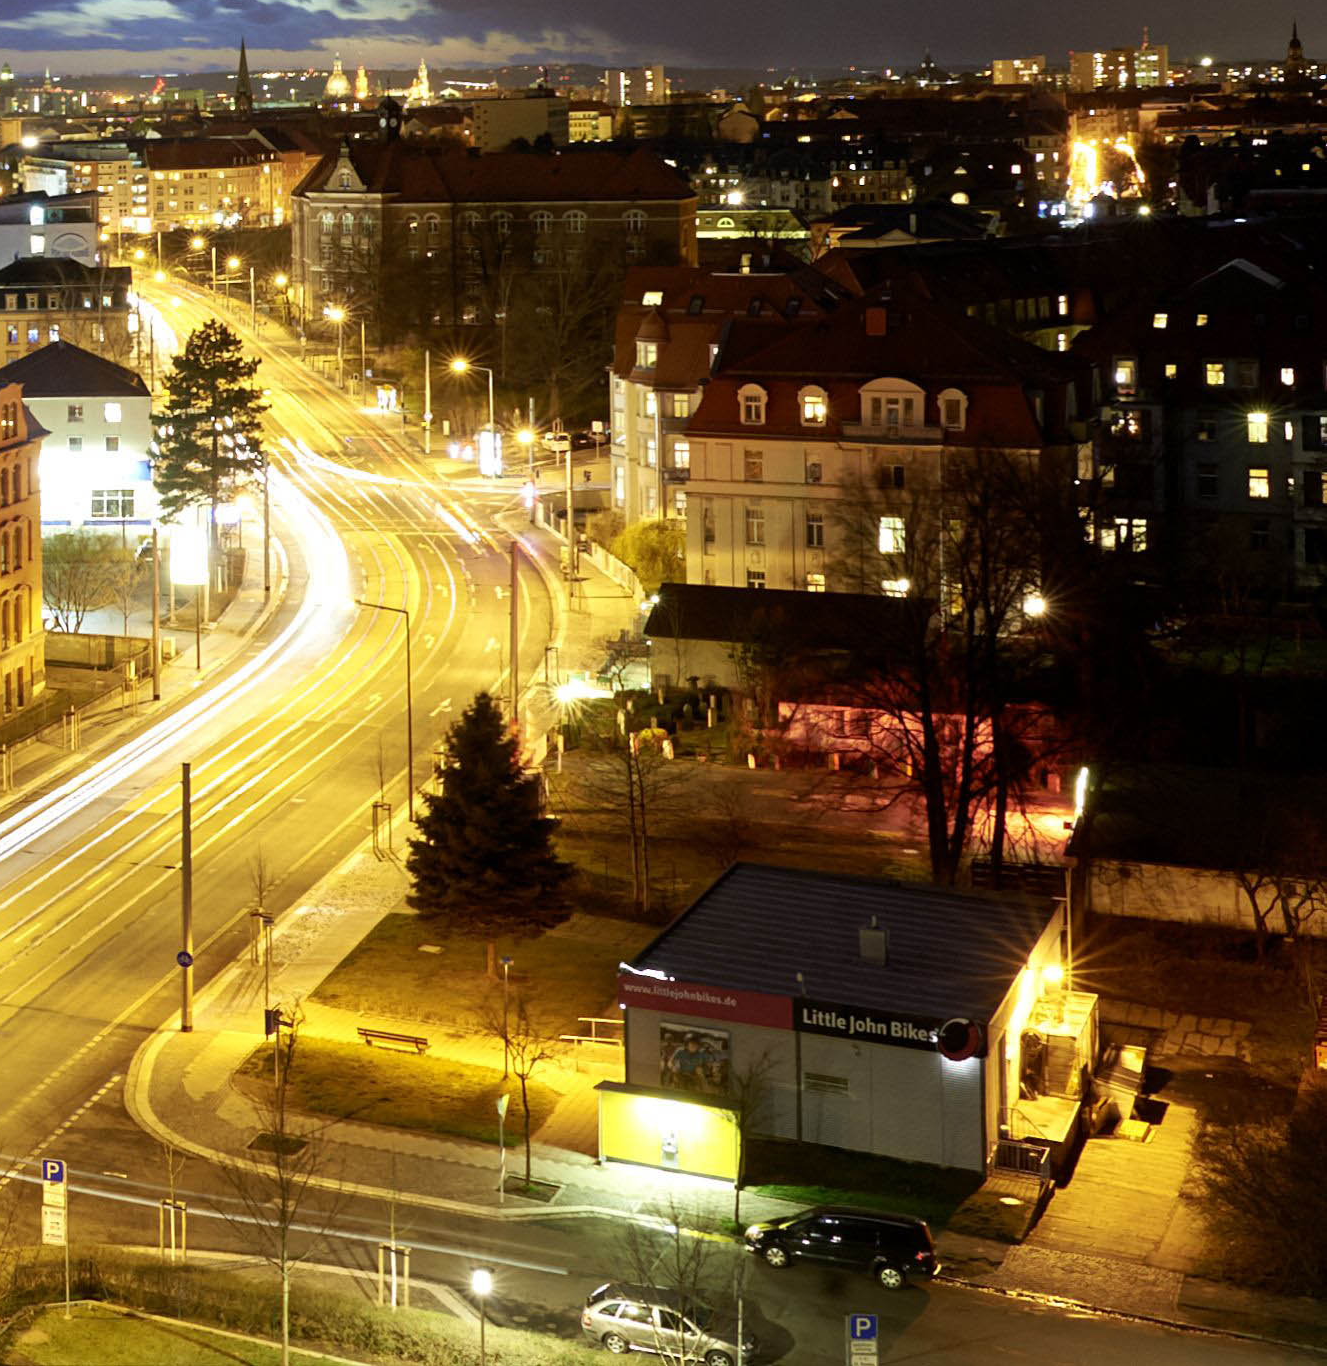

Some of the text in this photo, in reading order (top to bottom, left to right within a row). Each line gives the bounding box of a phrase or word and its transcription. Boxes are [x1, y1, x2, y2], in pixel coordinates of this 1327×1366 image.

[623, 981, 738, 1008] www.littlejohnbikes.de
[802, 1007, 939, 1044] Little John Bikes
[46, 1161, 60, 1179] P
[856, 1317, 871, 1337] P
